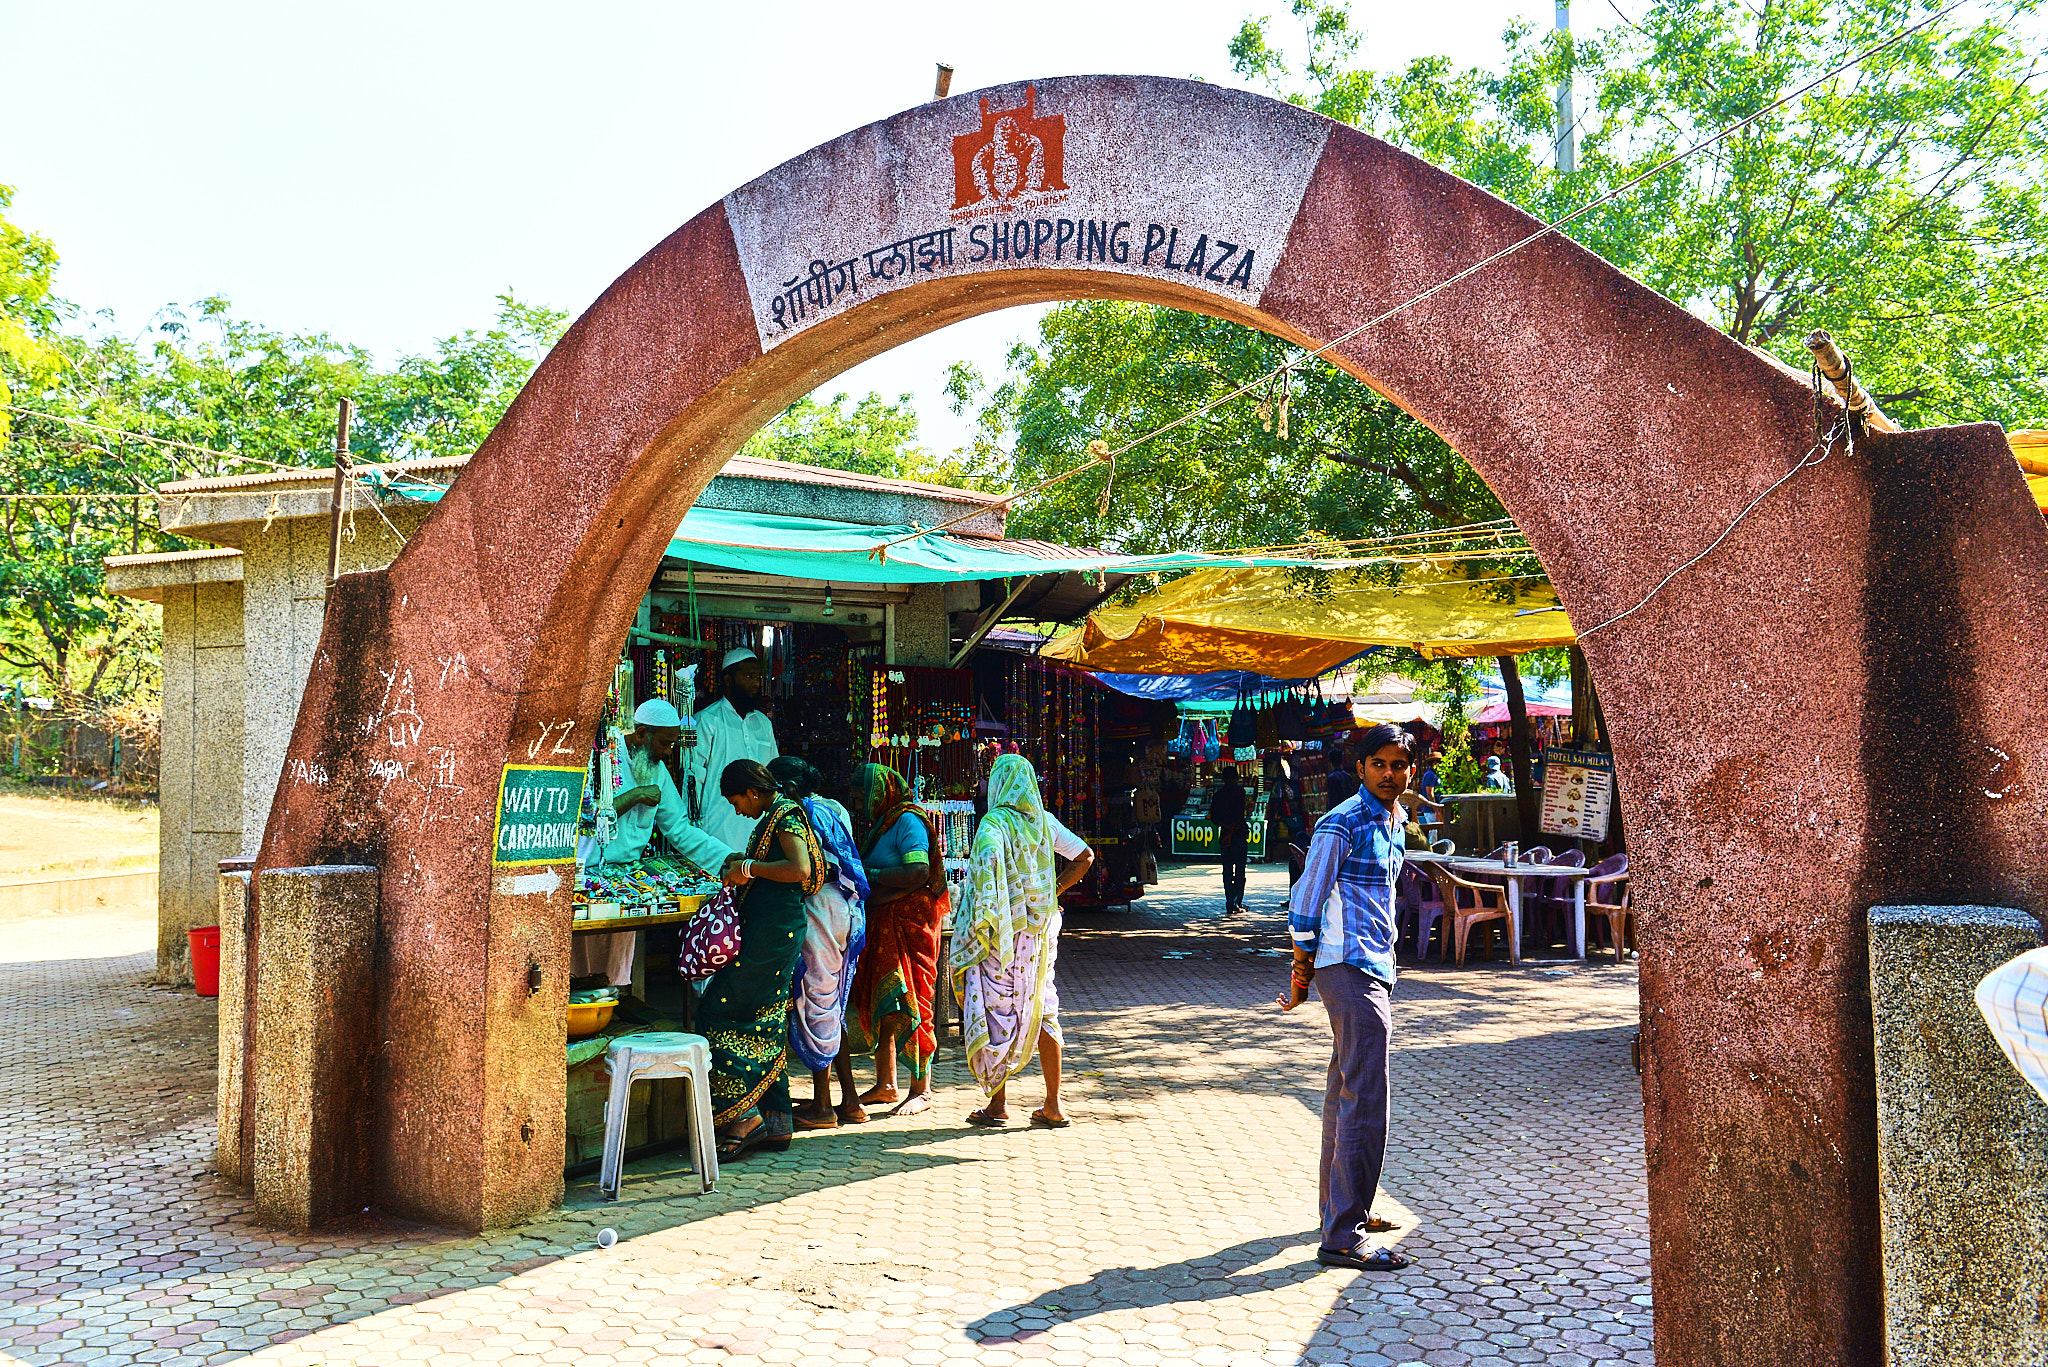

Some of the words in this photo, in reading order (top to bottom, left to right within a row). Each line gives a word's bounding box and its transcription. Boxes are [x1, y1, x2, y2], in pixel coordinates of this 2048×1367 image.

[771, 257, 859, 330] शॉपींग
[863, 228, 956, 280] प्लाझा
[969, 219, 1131, 264] SHOPPING
[1142, 223, 1256, 291] PLAZA
[1548, 751, 1571, 763] HOTEL
[1573, 754, 1585, 764] SAI
[1587, 756, 1610, 767] MILAN
[503, 786, 543, 813] WAY
[546, 787, 569, 814] TO
[499, 822, 577, 851] CARPARKING
[1176, 820, 1214, 847] Shop
